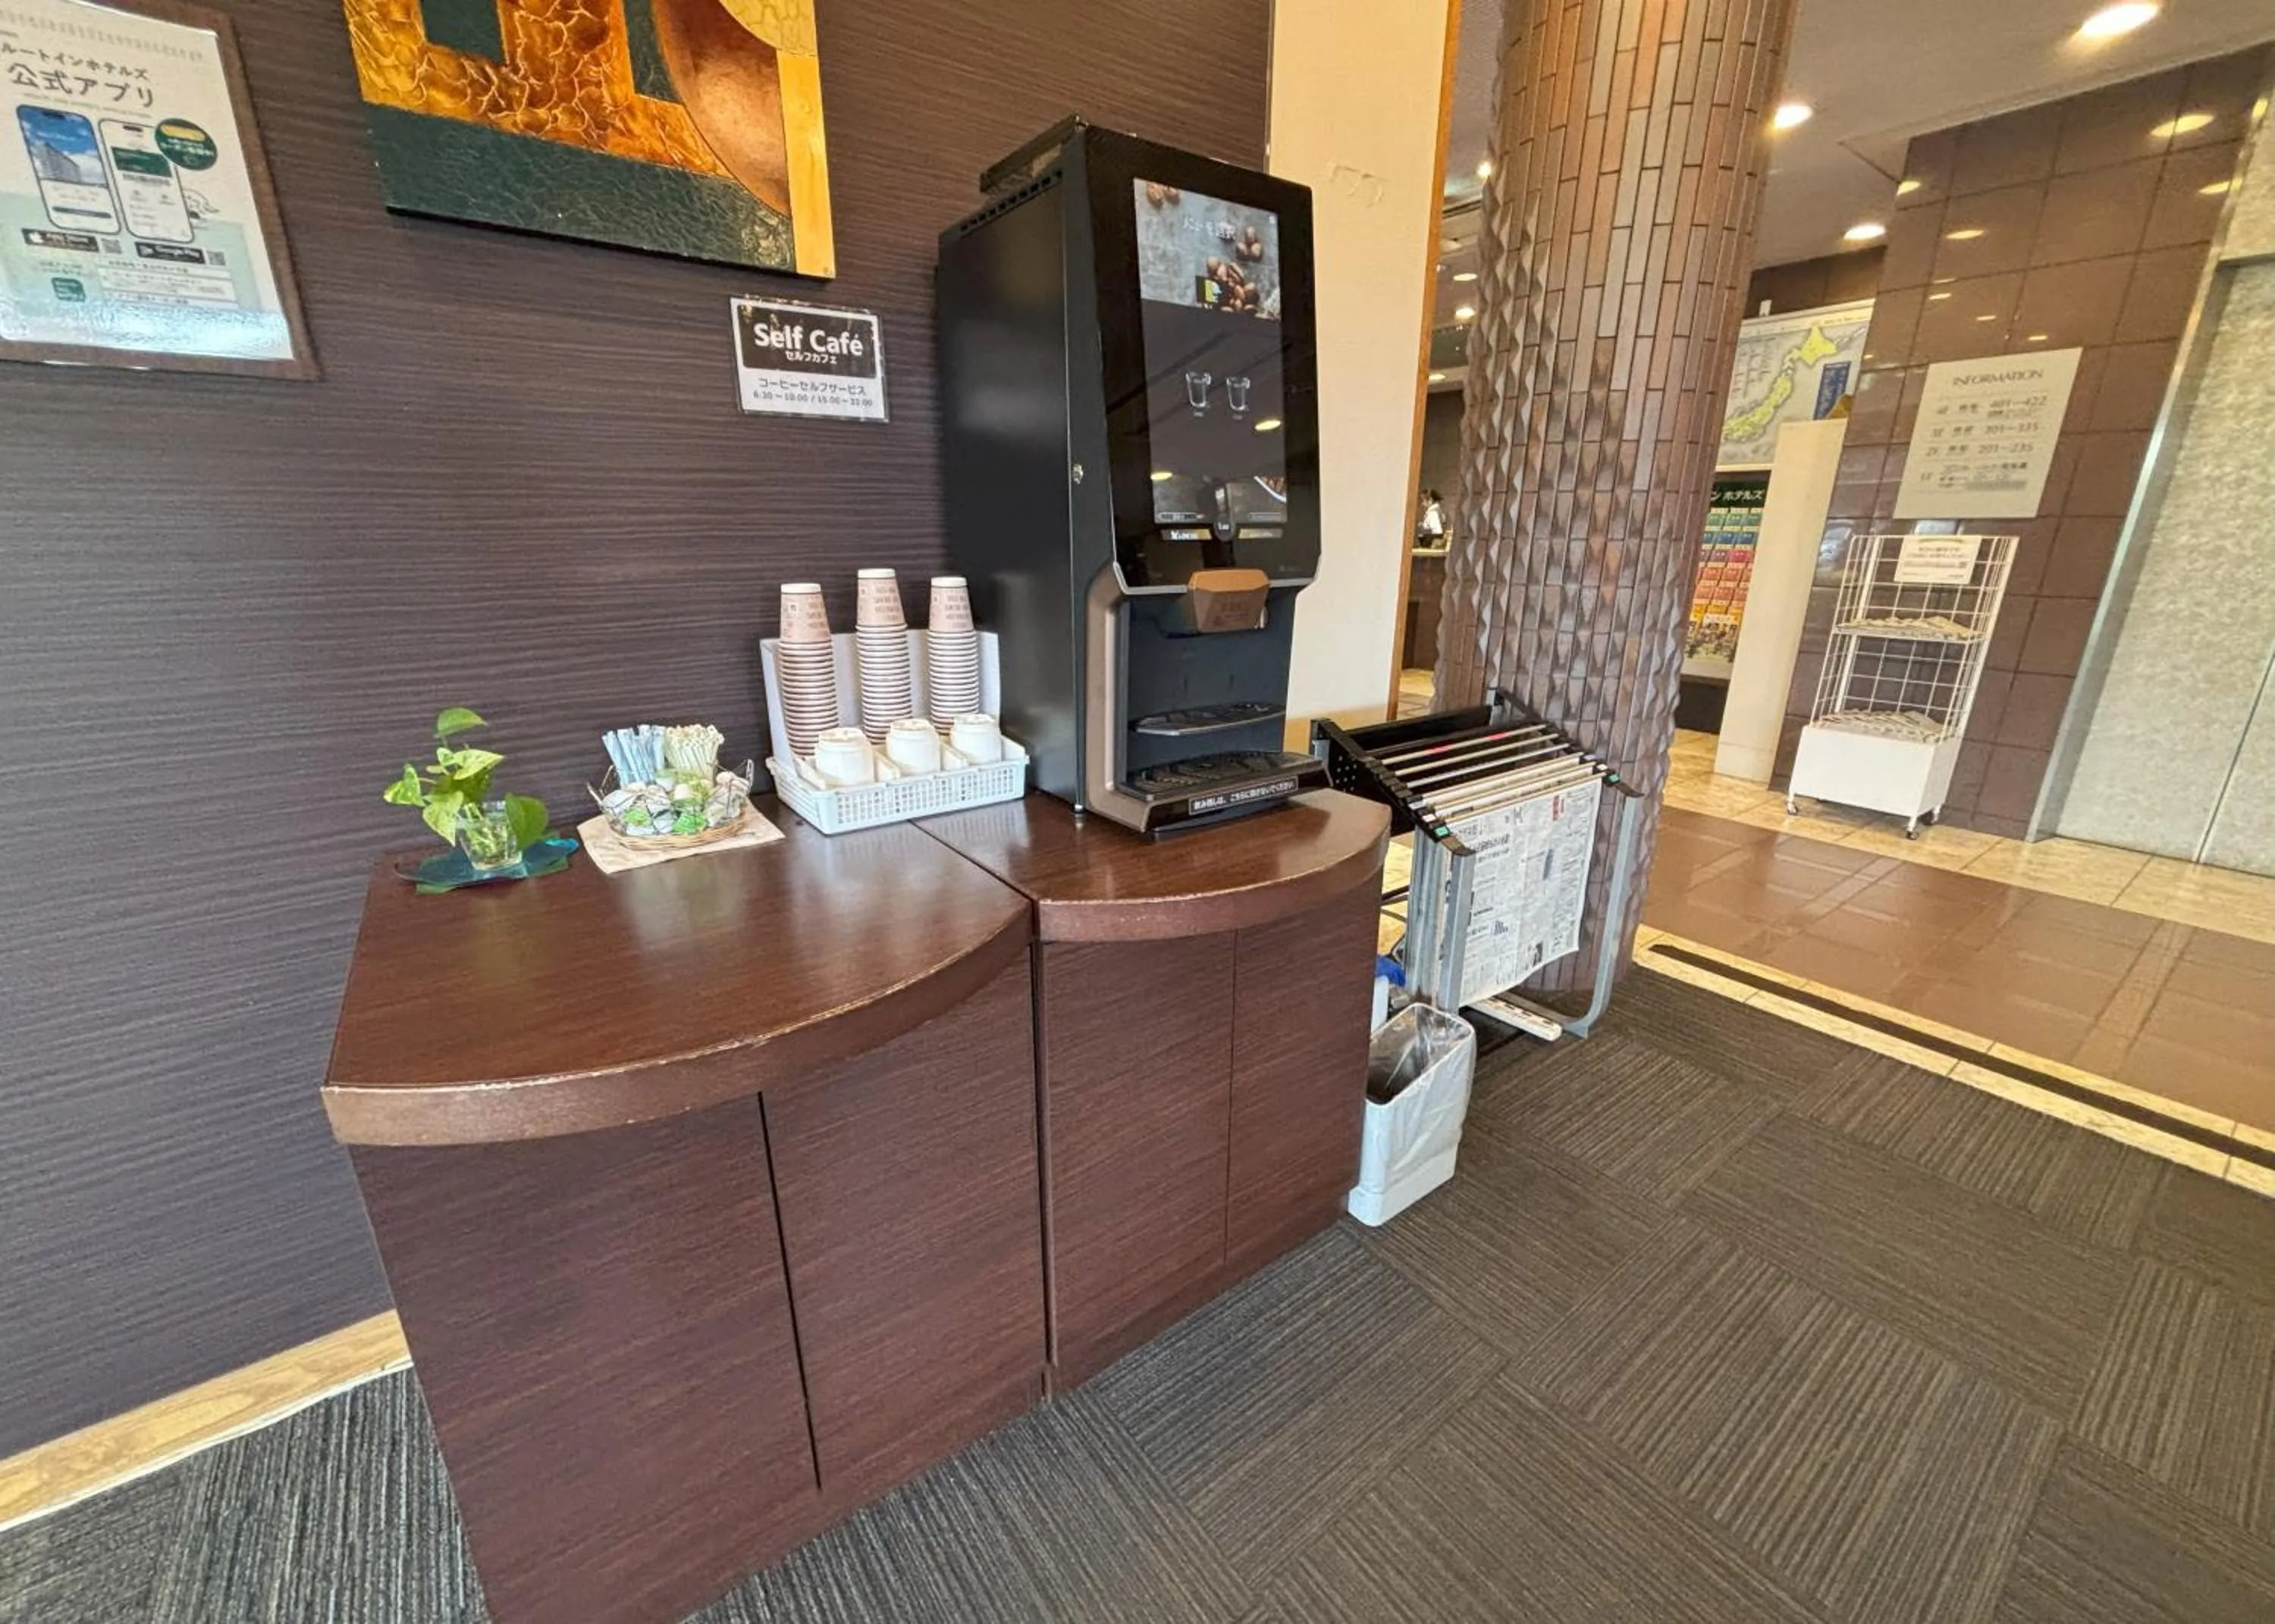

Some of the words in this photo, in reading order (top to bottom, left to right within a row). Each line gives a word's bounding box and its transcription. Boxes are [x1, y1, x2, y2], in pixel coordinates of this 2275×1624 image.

[1, 42, 149, 80] ルートインホテルズ
[7, 62, 154, 108] 公式アプリ
[753, 323, 803, 350] Self
[809, 329, 864, 356] Café
[785, 350, 838, 365] セルフカフェ
[758, 378, 867, 396] コーヒーセルフサービス
[1953, 368, 2044, 386] INFORMATION
